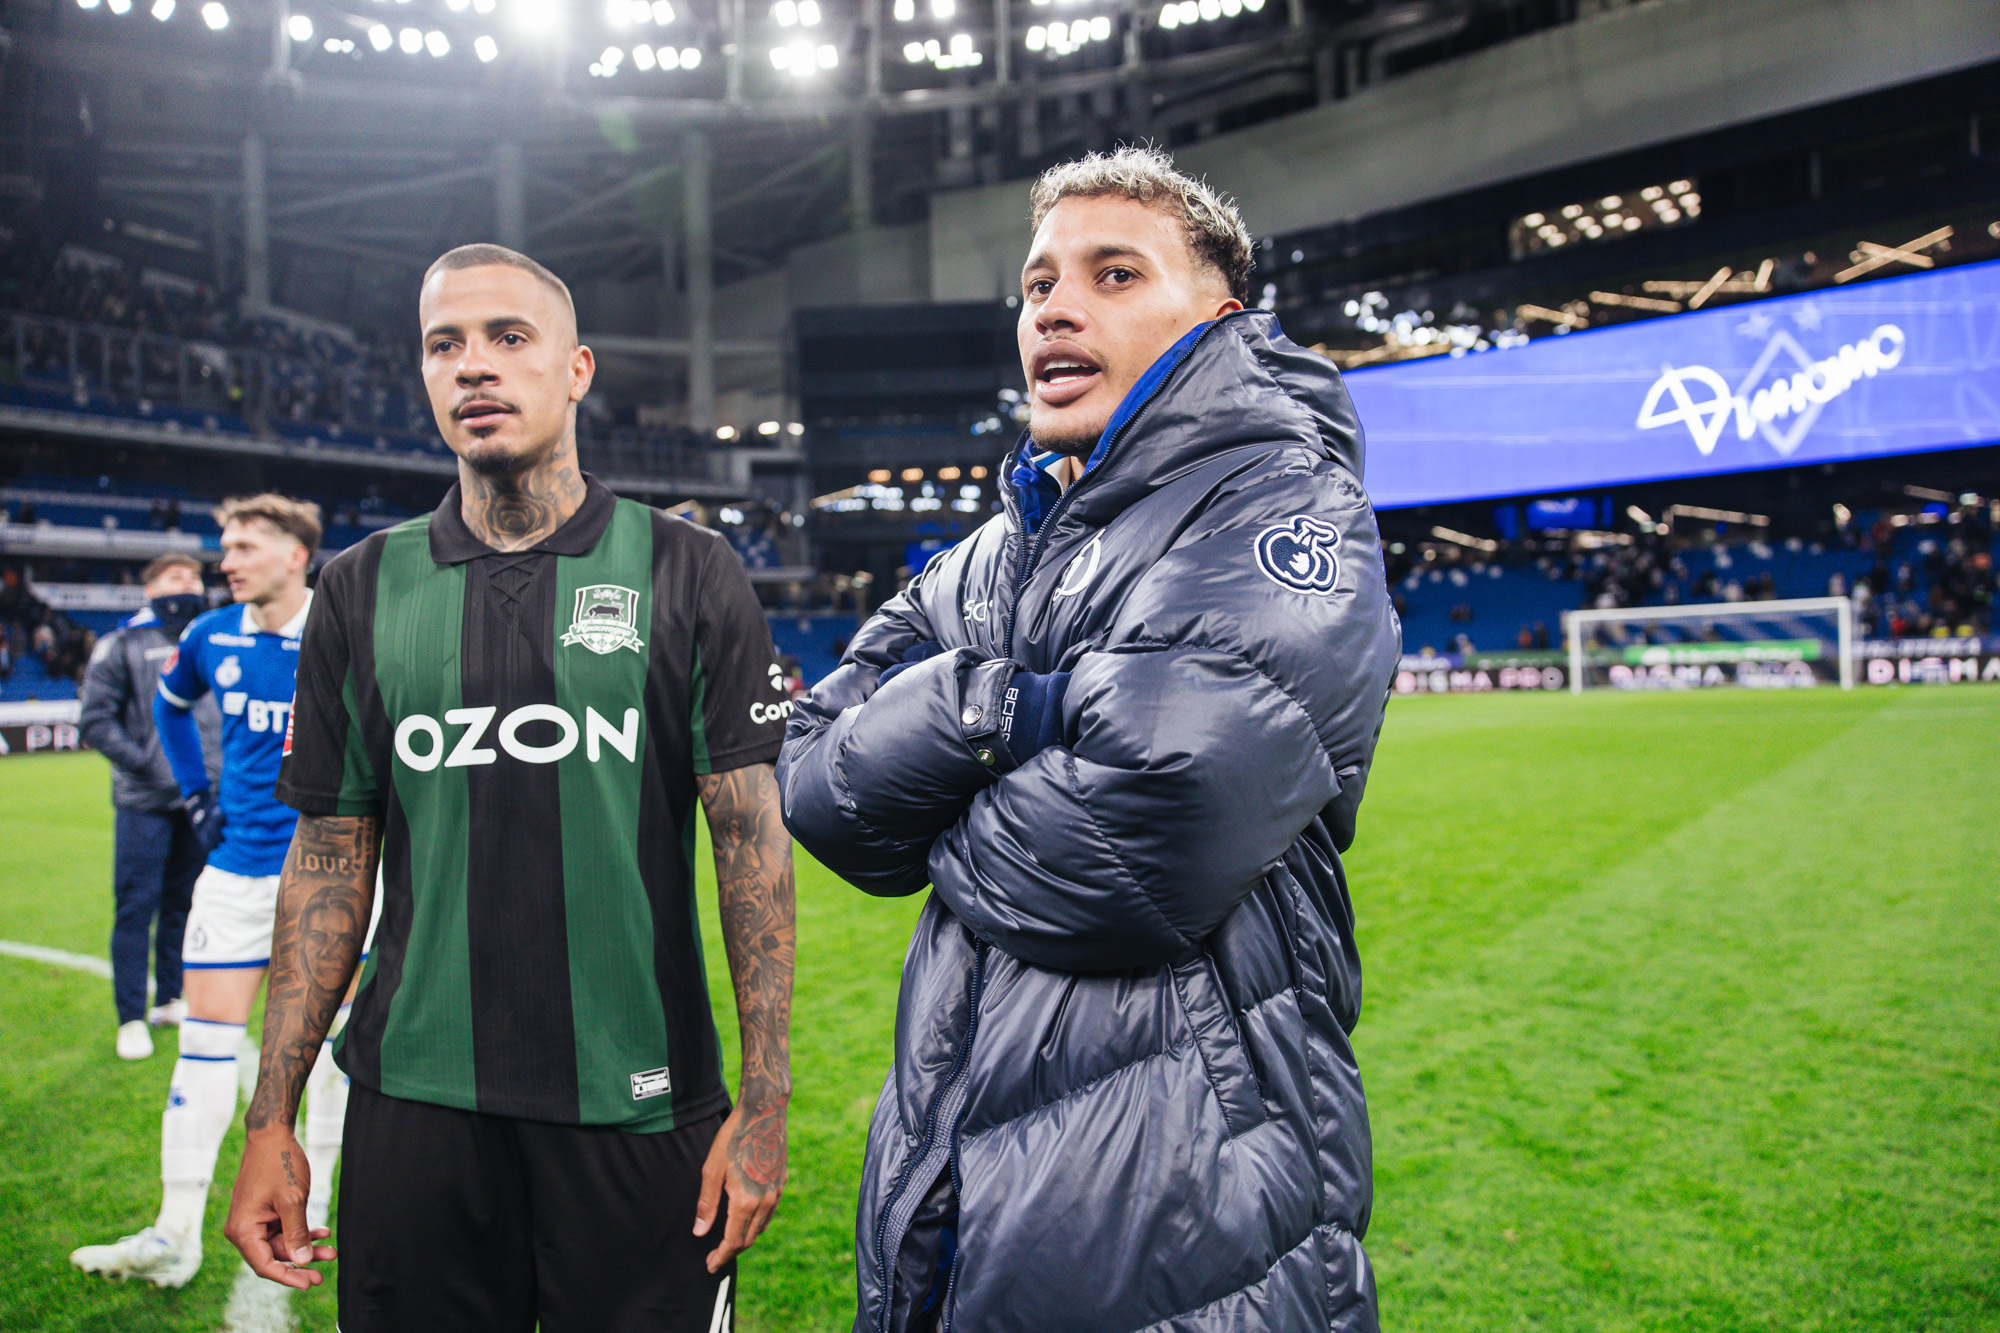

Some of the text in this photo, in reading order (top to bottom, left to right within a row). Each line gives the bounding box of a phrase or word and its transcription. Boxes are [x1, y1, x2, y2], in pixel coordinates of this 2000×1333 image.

[749, 699, 795, 725] Con
[26, 725, 84, 753] PR
[394, 703, 640, 773] OZON
